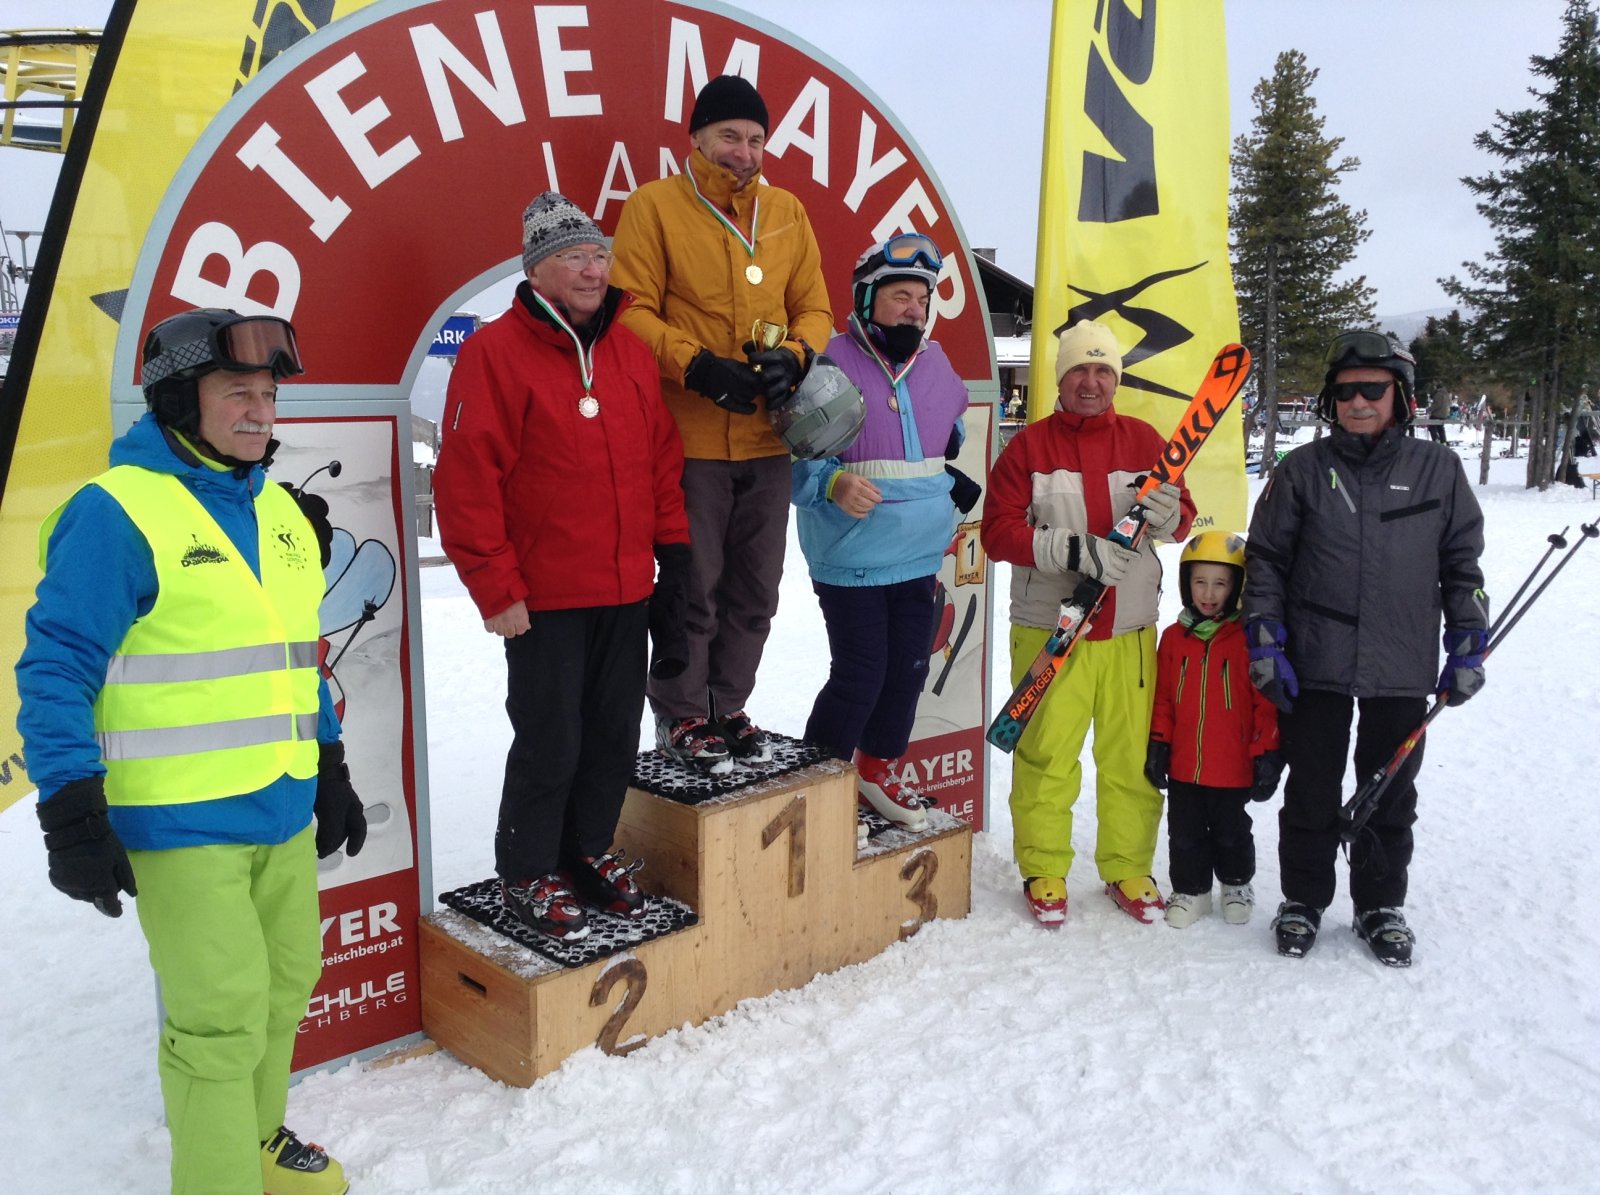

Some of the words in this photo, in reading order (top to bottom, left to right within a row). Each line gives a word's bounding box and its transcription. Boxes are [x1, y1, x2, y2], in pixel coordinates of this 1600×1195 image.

[169, 4, 604, 326] BIENE
[663, 16, 967, 340] MAYER
[432, 329, 466, 345] ARK
[967, 538, 975, 567] 1
[1009, 667, 1055, 721] RACETIGER
[901, 749, 973, 785] AYER
[761, 796, 807, 898] 1
[899, 848, 939, 942] 3
[321, 935, 404, 968] reischberg.at
[304, 970, 406, 1018] CHULE
[588, 952, 649, 1057] 2
